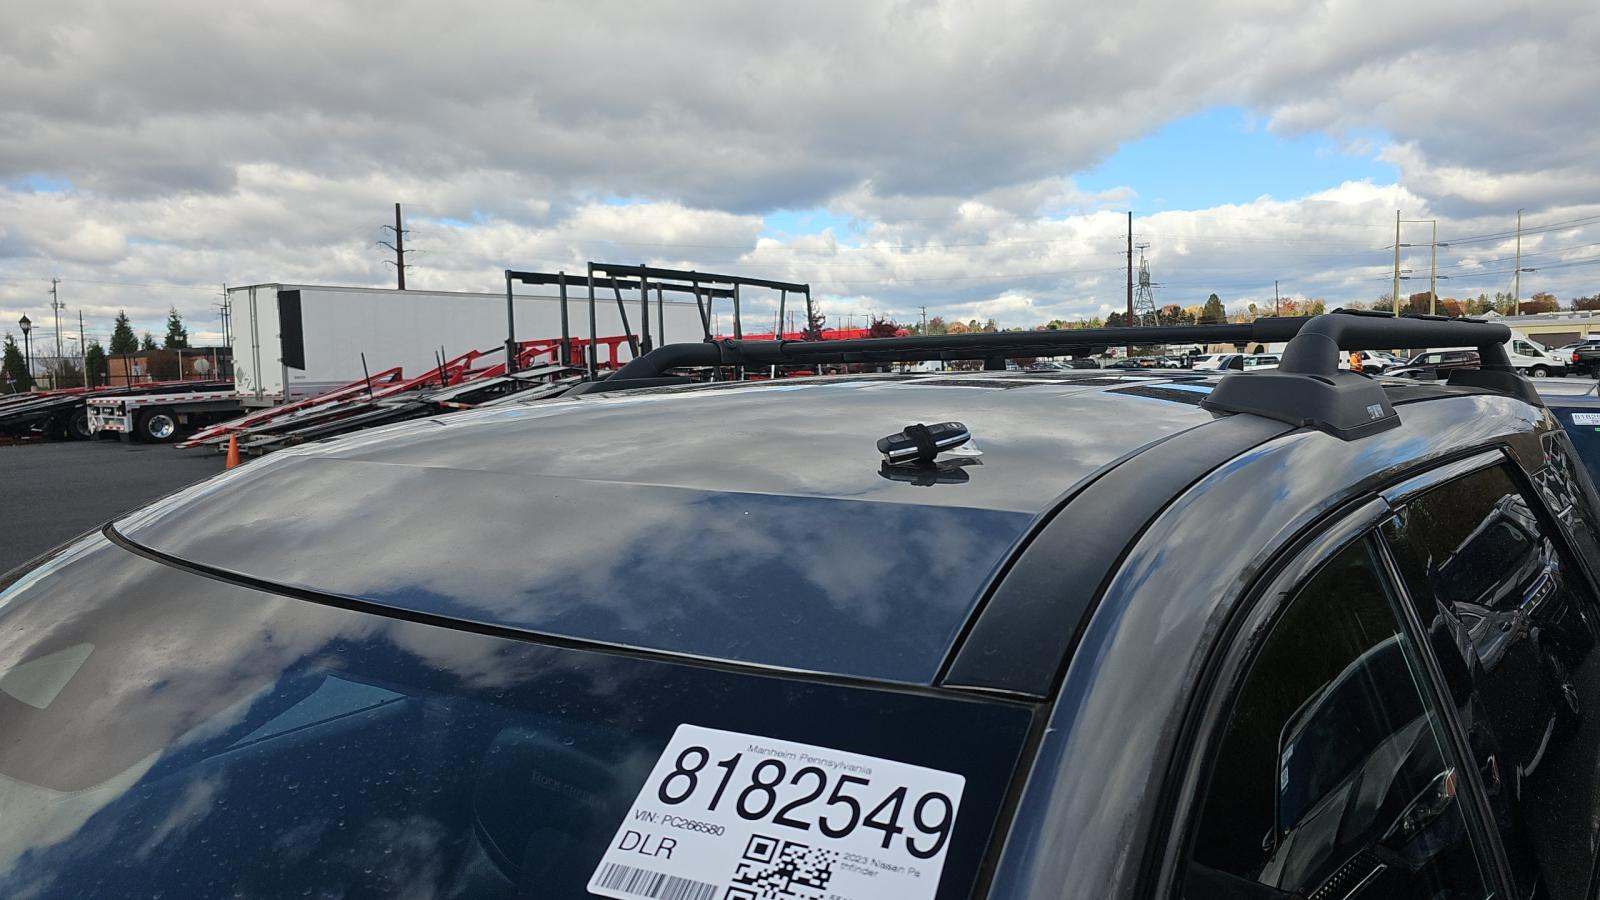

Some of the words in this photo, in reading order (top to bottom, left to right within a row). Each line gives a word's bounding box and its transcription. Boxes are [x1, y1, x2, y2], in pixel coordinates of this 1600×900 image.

[747, 744, 797, 760] Manheim
[799, 753, 873, 776] Pennsylvania
[658, 746, 953, 860] 8182549
[634, 809, 660, 823] VIN:
[661, 814, 726, 837] PC266580
[618, 830, 677, 860] DLR
[843, 852, 868, 865] 2023
[869, 859, 905, 874] Nissan
